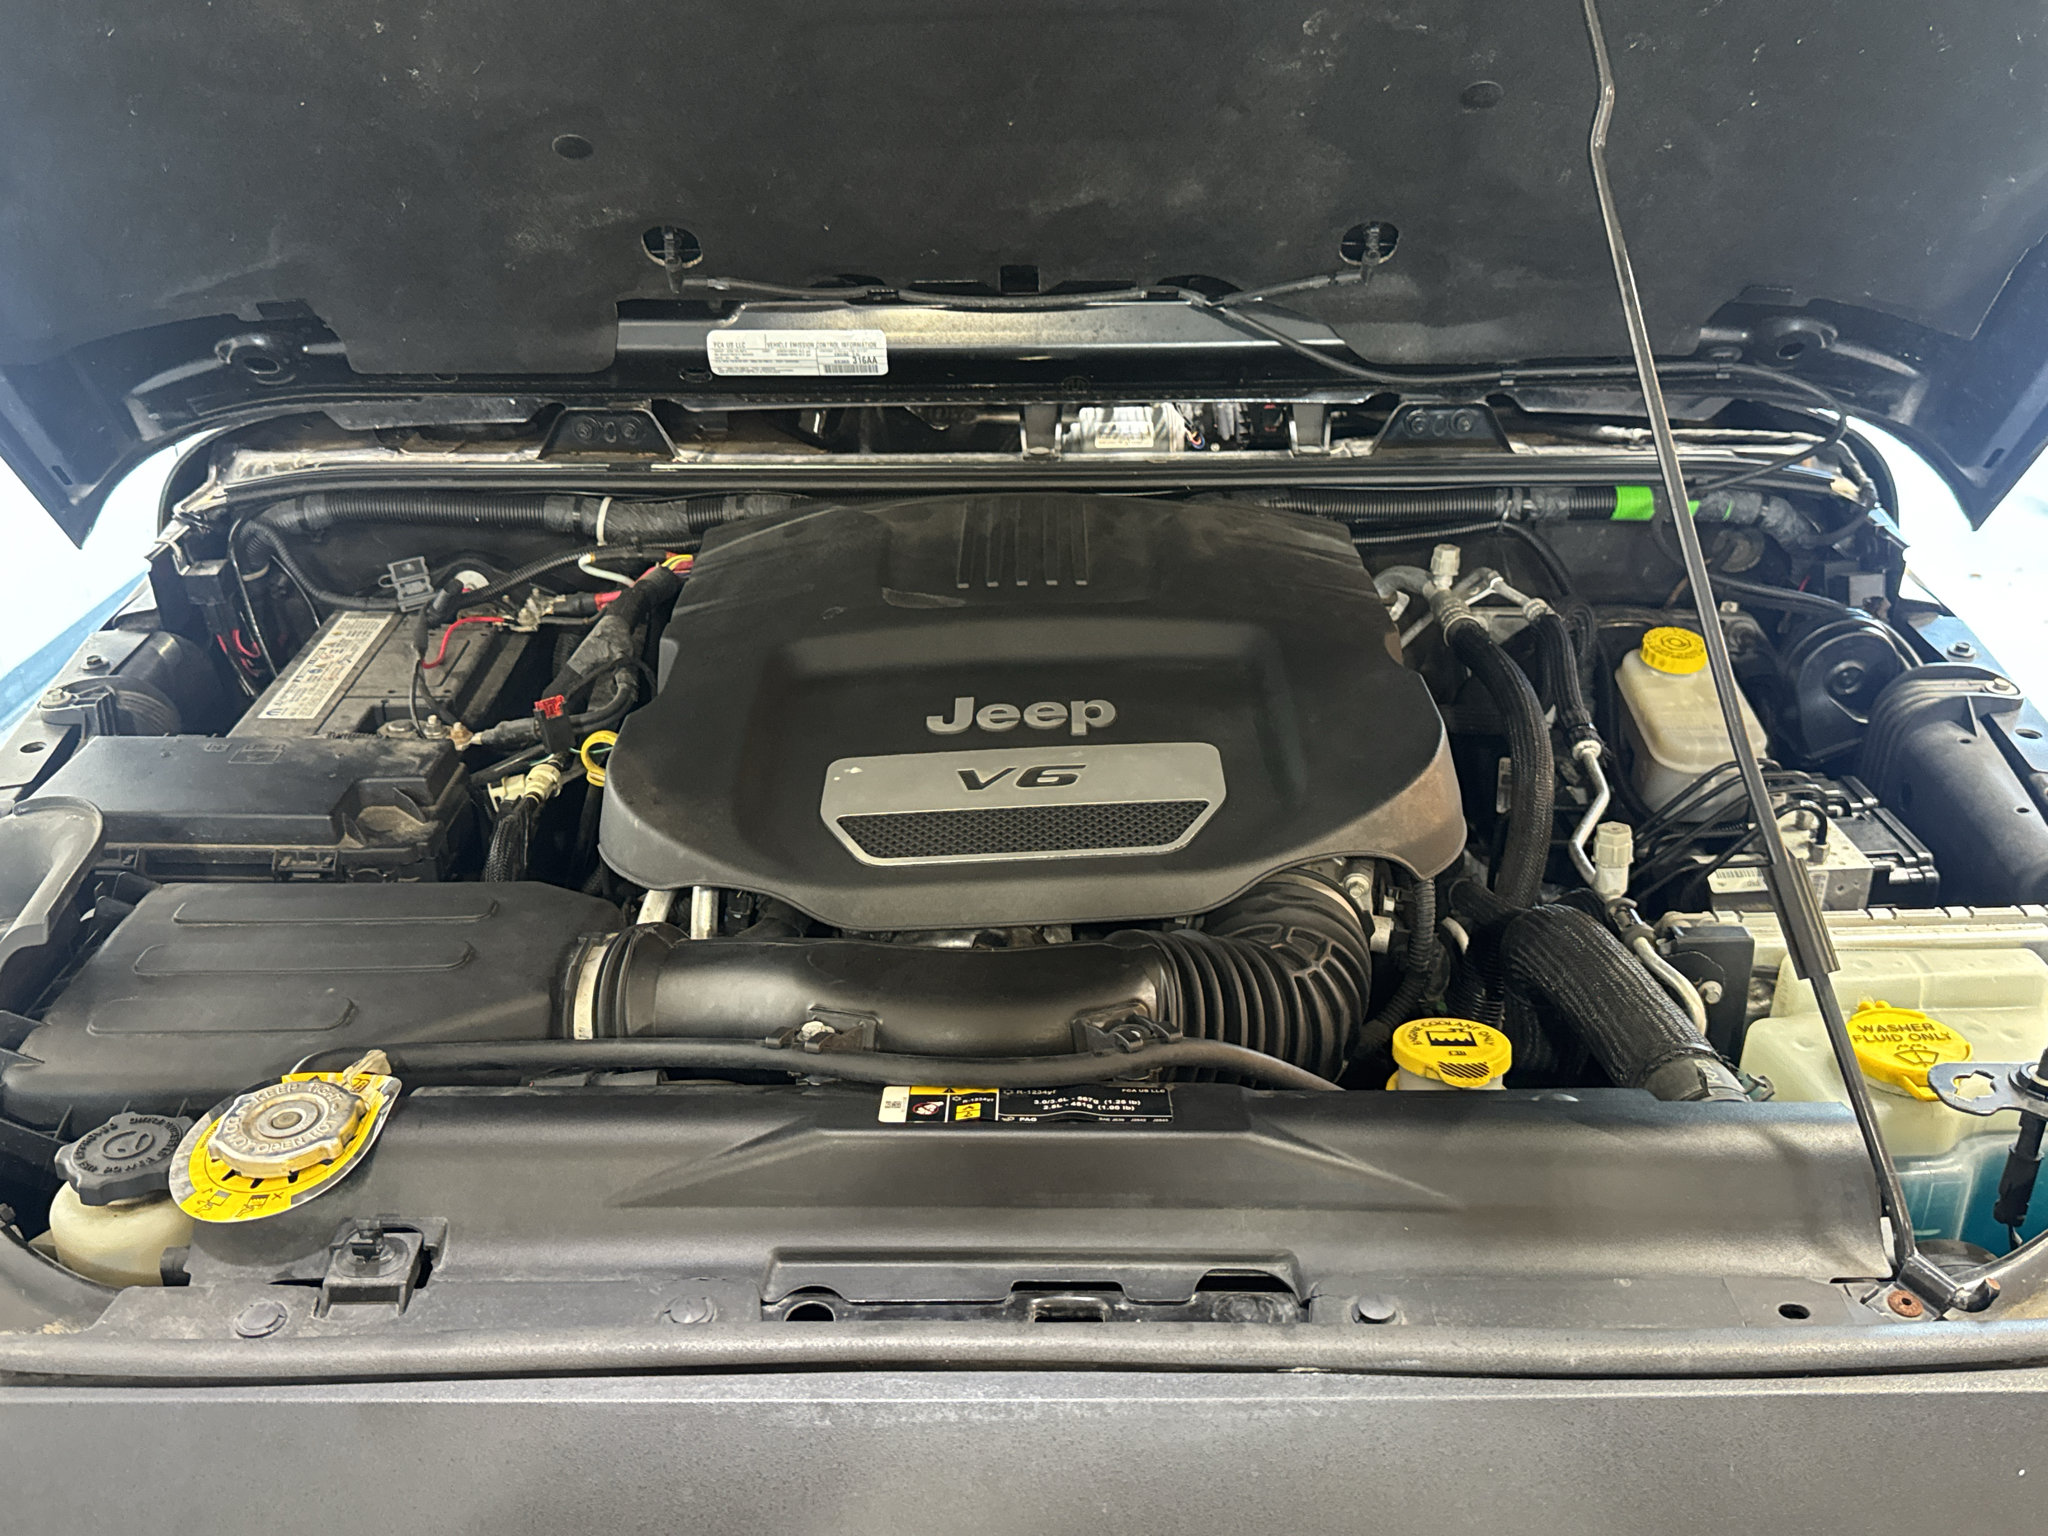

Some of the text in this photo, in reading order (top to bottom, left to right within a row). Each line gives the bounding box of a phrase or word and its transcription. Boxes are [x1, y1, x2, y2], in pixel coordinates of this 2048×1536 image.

[926, 697, 1117, 736] Jeep
[956, 764, 1087, 790] V6
[1421, 1020, 1480, 1030] COOLANT
[1477, 1030, 1497, 1047] ONLY
[1852, 1031, 1952, 1044] FLUID ONLY
[1856, 1022, 1935, 1033] WASHER
[255, 1082, 344, 1103] KEEP TIGHT
[256, 1137, 306, 1154] OPEN
[307, 1119, 337, 1140] HOT
